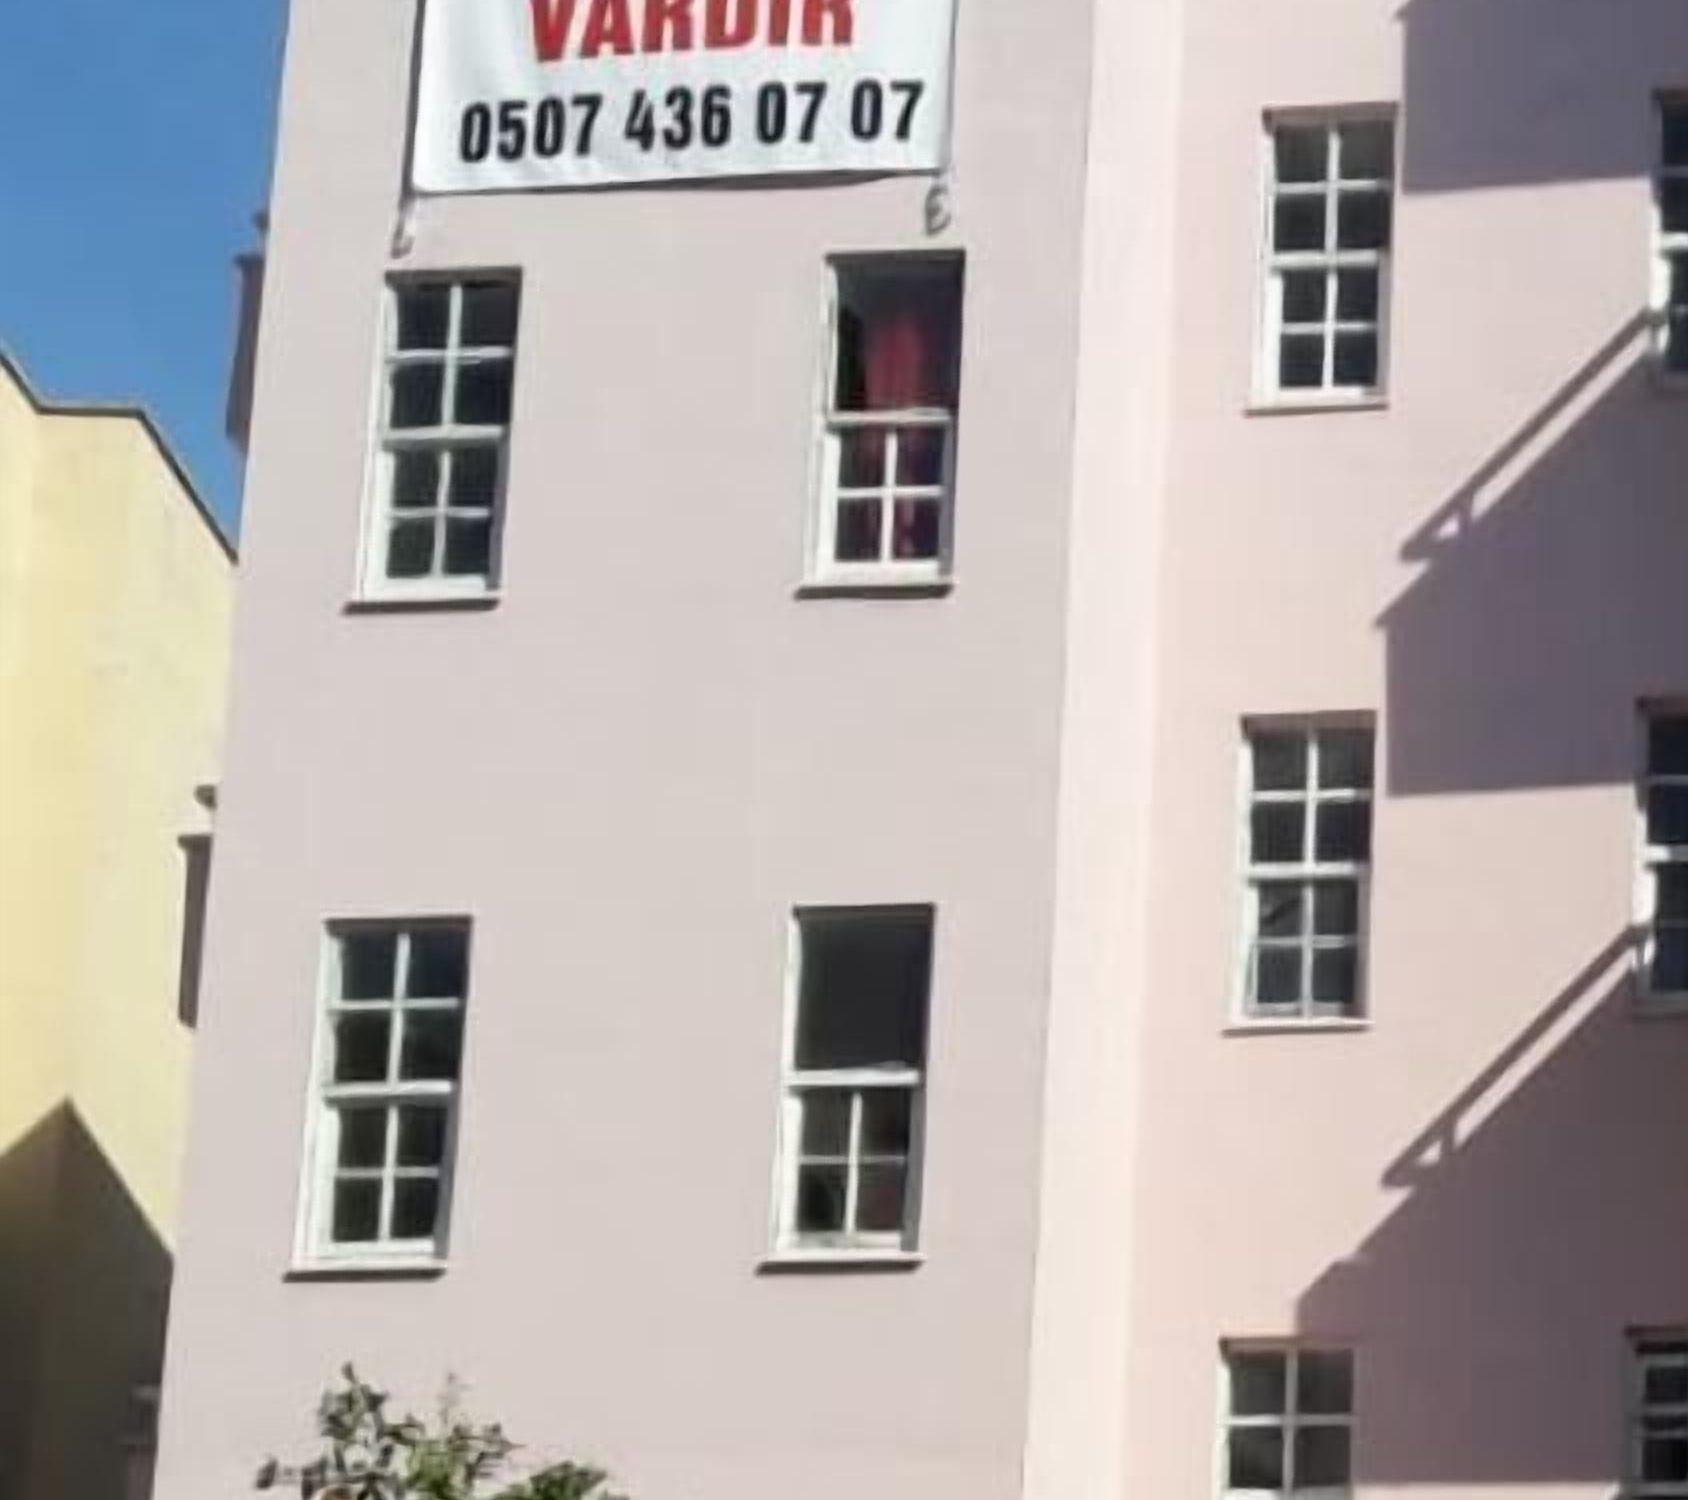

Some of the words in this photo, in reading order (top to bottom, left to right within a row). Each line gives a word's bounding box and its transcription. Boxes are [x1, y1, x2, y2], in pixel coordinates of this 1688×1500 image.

[459, 93, 603, 164] 0507
[624, 84, 732, 152] 436
[756, 81, 827, 146] 07
[850, 79, 924, 142] 07
